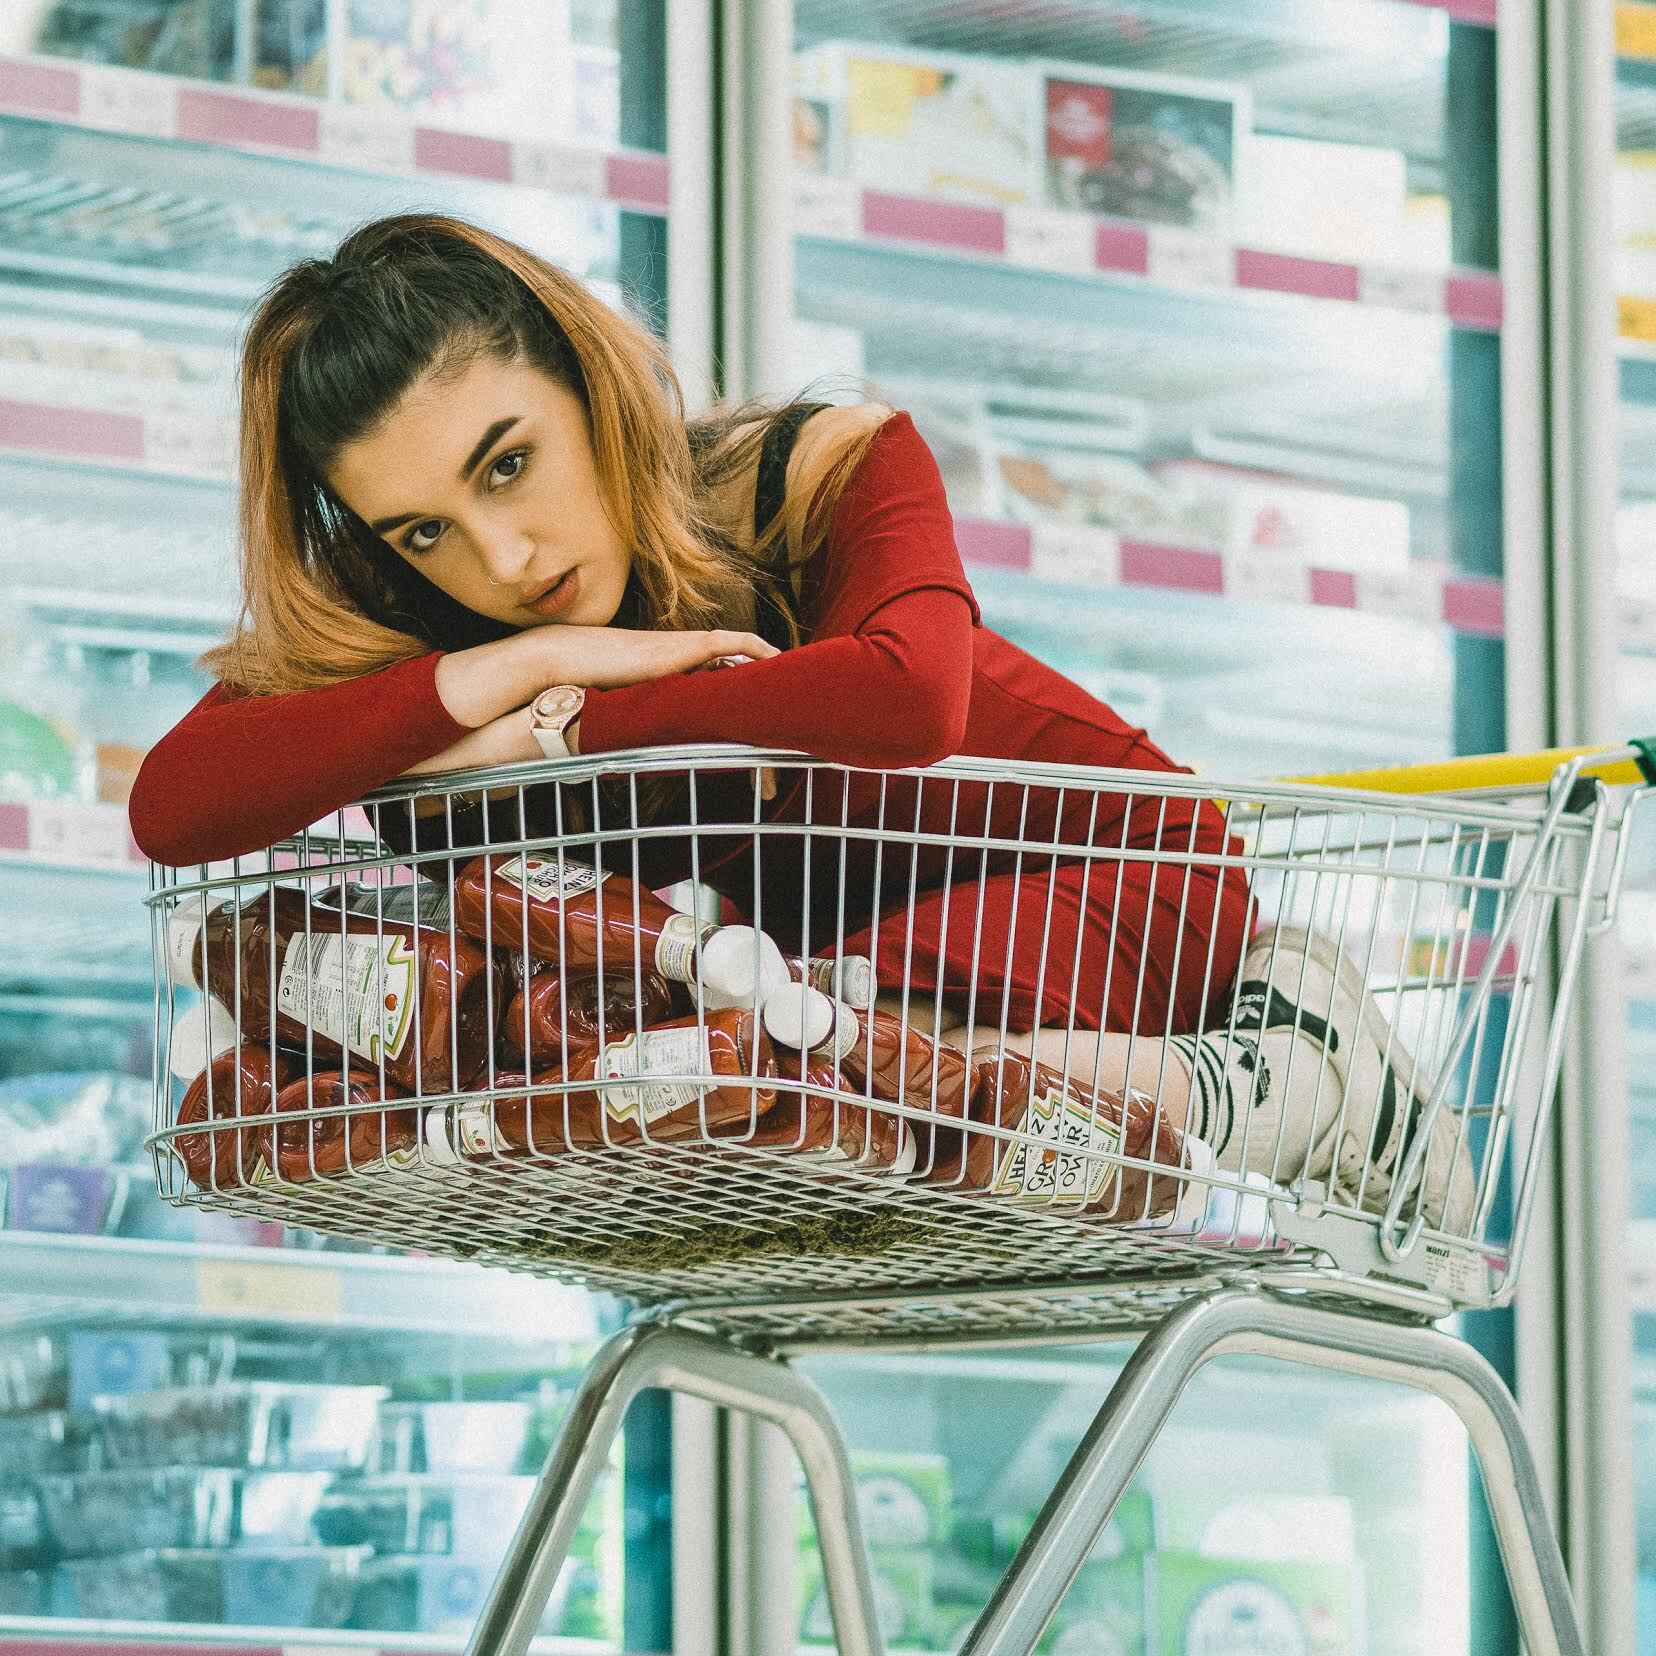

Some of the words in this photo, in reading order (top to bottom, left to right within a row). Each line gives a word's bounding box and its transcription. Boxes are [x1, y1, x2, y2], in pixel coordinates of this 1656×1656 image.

[539, 865, 586, 888] OMATO
[1238, 994, 1266, 1004] adid
[1008, 1118, 1045, 1180] HEZ
[1062, 1133, 1090, 1187] OWN
